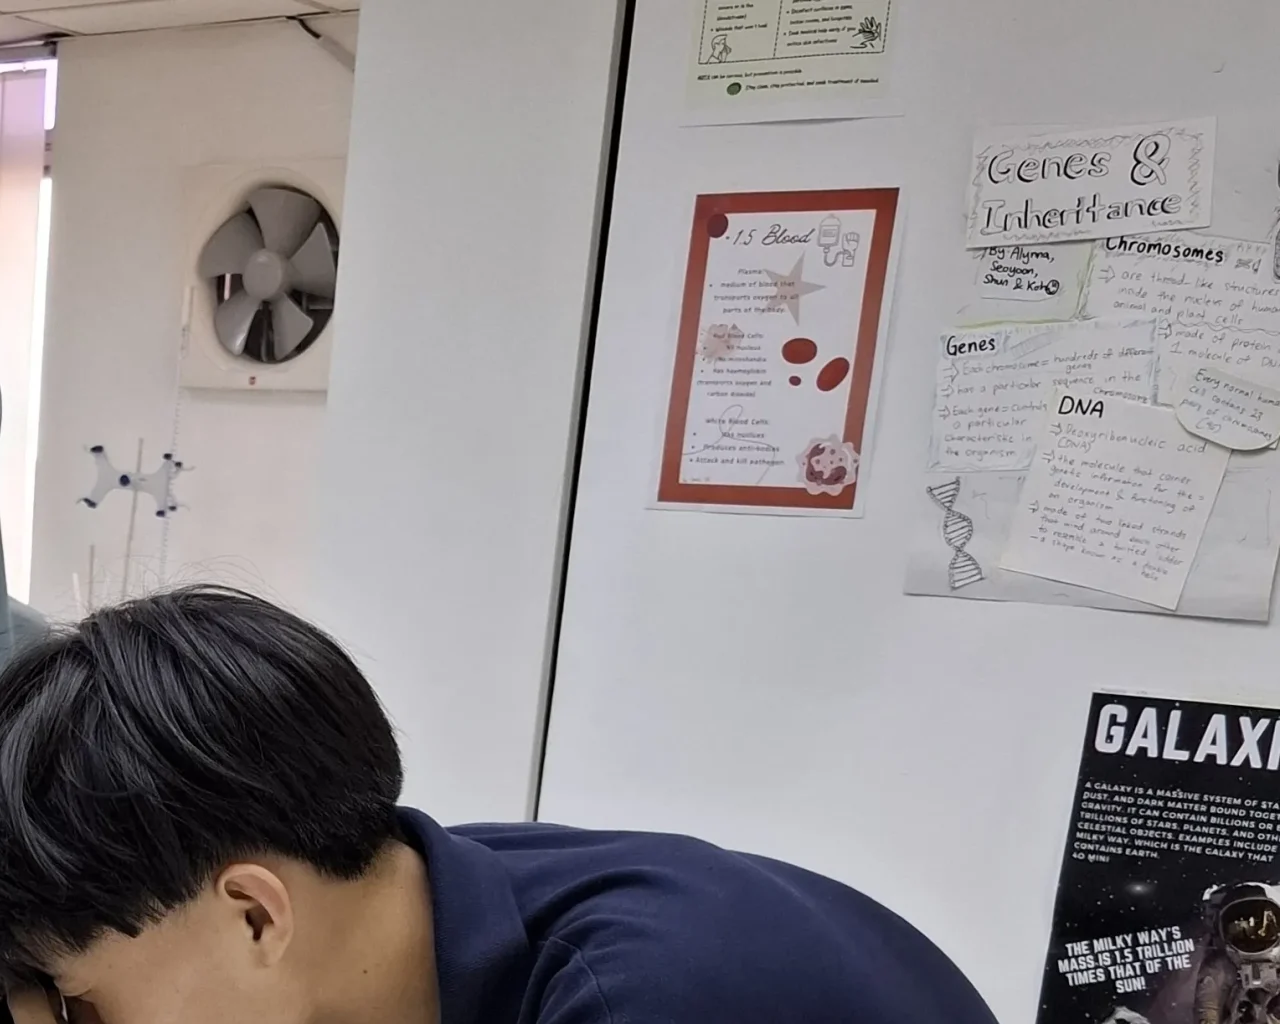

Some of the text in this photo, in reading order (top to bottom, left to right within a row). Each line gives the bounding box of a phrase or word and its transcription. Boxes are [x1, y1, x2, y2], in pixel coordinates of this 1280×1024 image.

[988, 133, 1171, 186] Genes &
[980, 192, 1182, 235] Inheritance
[761, 223, 816, 246] Blood
[988, 246, 1005, 259] By
[1106, 237, 1224, 263] Chromosomes
[1013, 280, 1023, 291] &
[1121, 271, 1280, 296] are structures
[1113, 301, 1146, 310] animal
[1151, 305, 1172, 316] and
[1176, 309, 1205, 323] plant
[1230, 299, 1243, 312] of
[946, 335, 996, 357] Genes
[1175, 329, 1271, 351] made of protein
[1188, 348, 1232, 363] molecule
[1261, 356, 1280, 368] DN
[1195, 368, 1254, 399] Every normal
[1057, 394, 1105, 419] DNA
[967, 418, 1027, 431] particular
[1020, 433, 1032, 442] in
[1176, 442, 1207, 454] acid
[1058, 455, 1074, 466] the
[1080, 459, 1125, 473] molecule
[1094, 782, 1133, 792] GALAXY
[1156, 788, 1200, 801] MASSIVE
[1203, 794, 1242, 805] SYSTEM
[1113, 795, 1135, 803] AND
[1137, 798, 1164, 807] DARK
[1167, 800, 1207, 812] MATTER
[1210, 806, 1246, 816] BOUND
[1080, 811, 1128, 823] TRILLIONS
[1232, 830, 1255, 839] AND
[1139, 808, 1160, 817] CAN
[1162, 811, 1207, 822] CONTAIN
[1210, 816, 1255, 828] BILLIONS
[1073, 841, 1123, 854] CONTAINS
[1076, 831, 1105, 840] MILKY
[1134, 839, 1168, 849] WHICH
[1171, 843, 1180, 851] IS
[1183, 845, 1203, 854] THE
[1205, 848, 1245, 858] GALAXY
[1246, 852, 1274, 862] THAT
[1077, 822, 1127, 834] CELESTIAL
[1178, 833, 1230, 846] EXAMPLES
[1233, 841, 1278, 853] INCLUDE
[1065, 926, 1182, 956] THE MILKY WAY'S
[1057, 938, 1195, 973] MASS IS 1.5 TRILLION
[1065, 954, 1192, 987] TIMES THAT OF THE
[1115, 976, 1147, 994] SUN!
